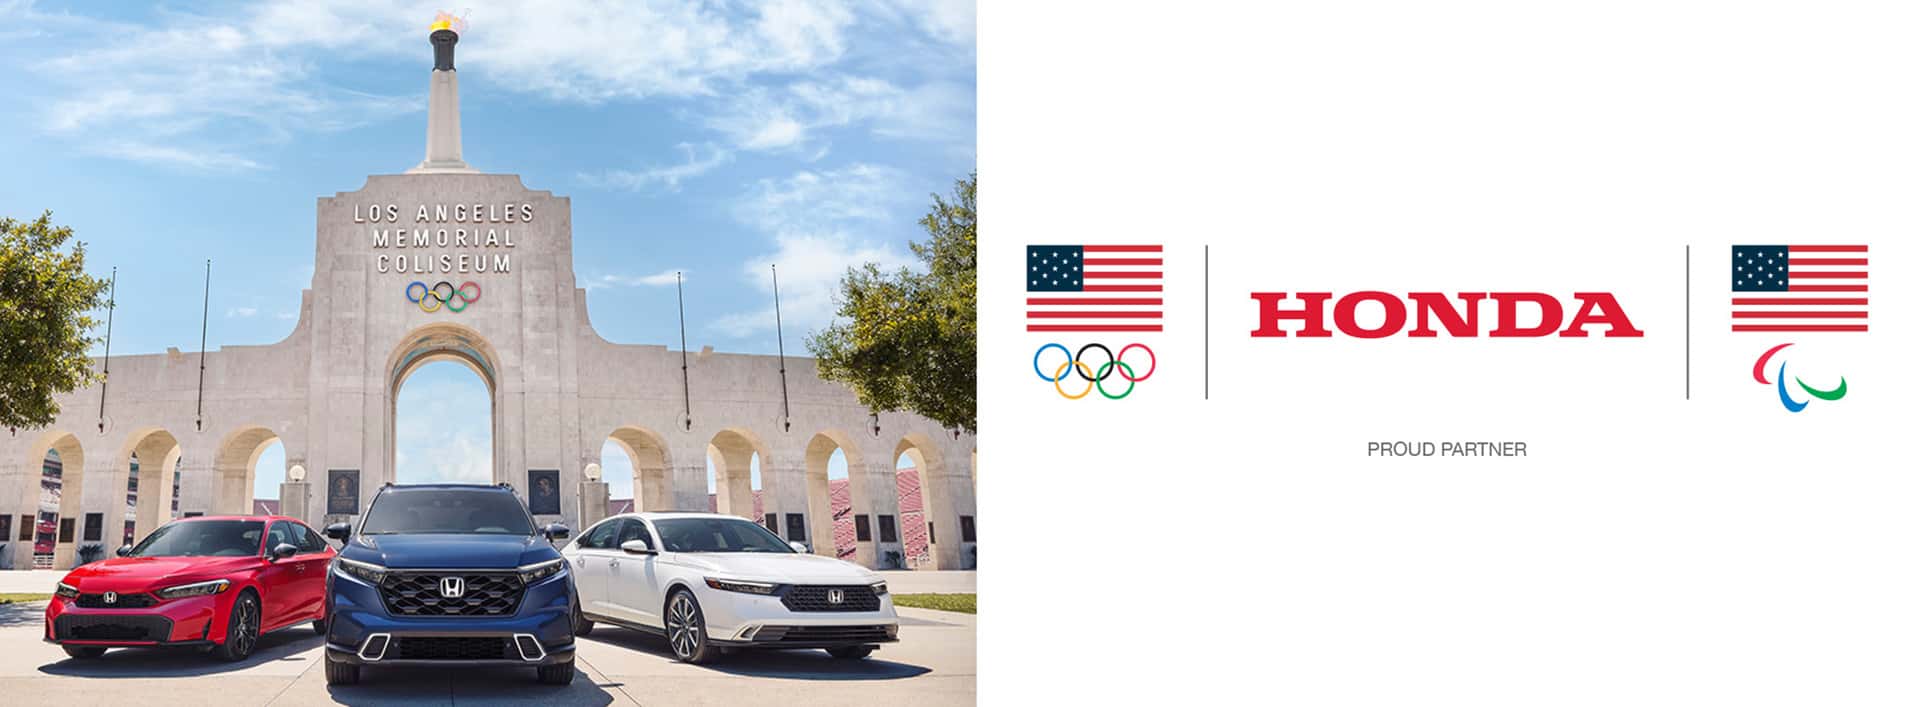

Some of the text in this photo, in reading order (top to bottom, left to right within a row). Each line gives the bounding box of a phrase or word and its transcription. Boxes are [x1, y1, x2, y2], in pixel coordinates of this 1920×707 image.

[354, 204, 534, 223] LOS ANGELES
[373, 229, 515, 247] MEMORIAL
[377, 254, 511, 273] COLISEUM
